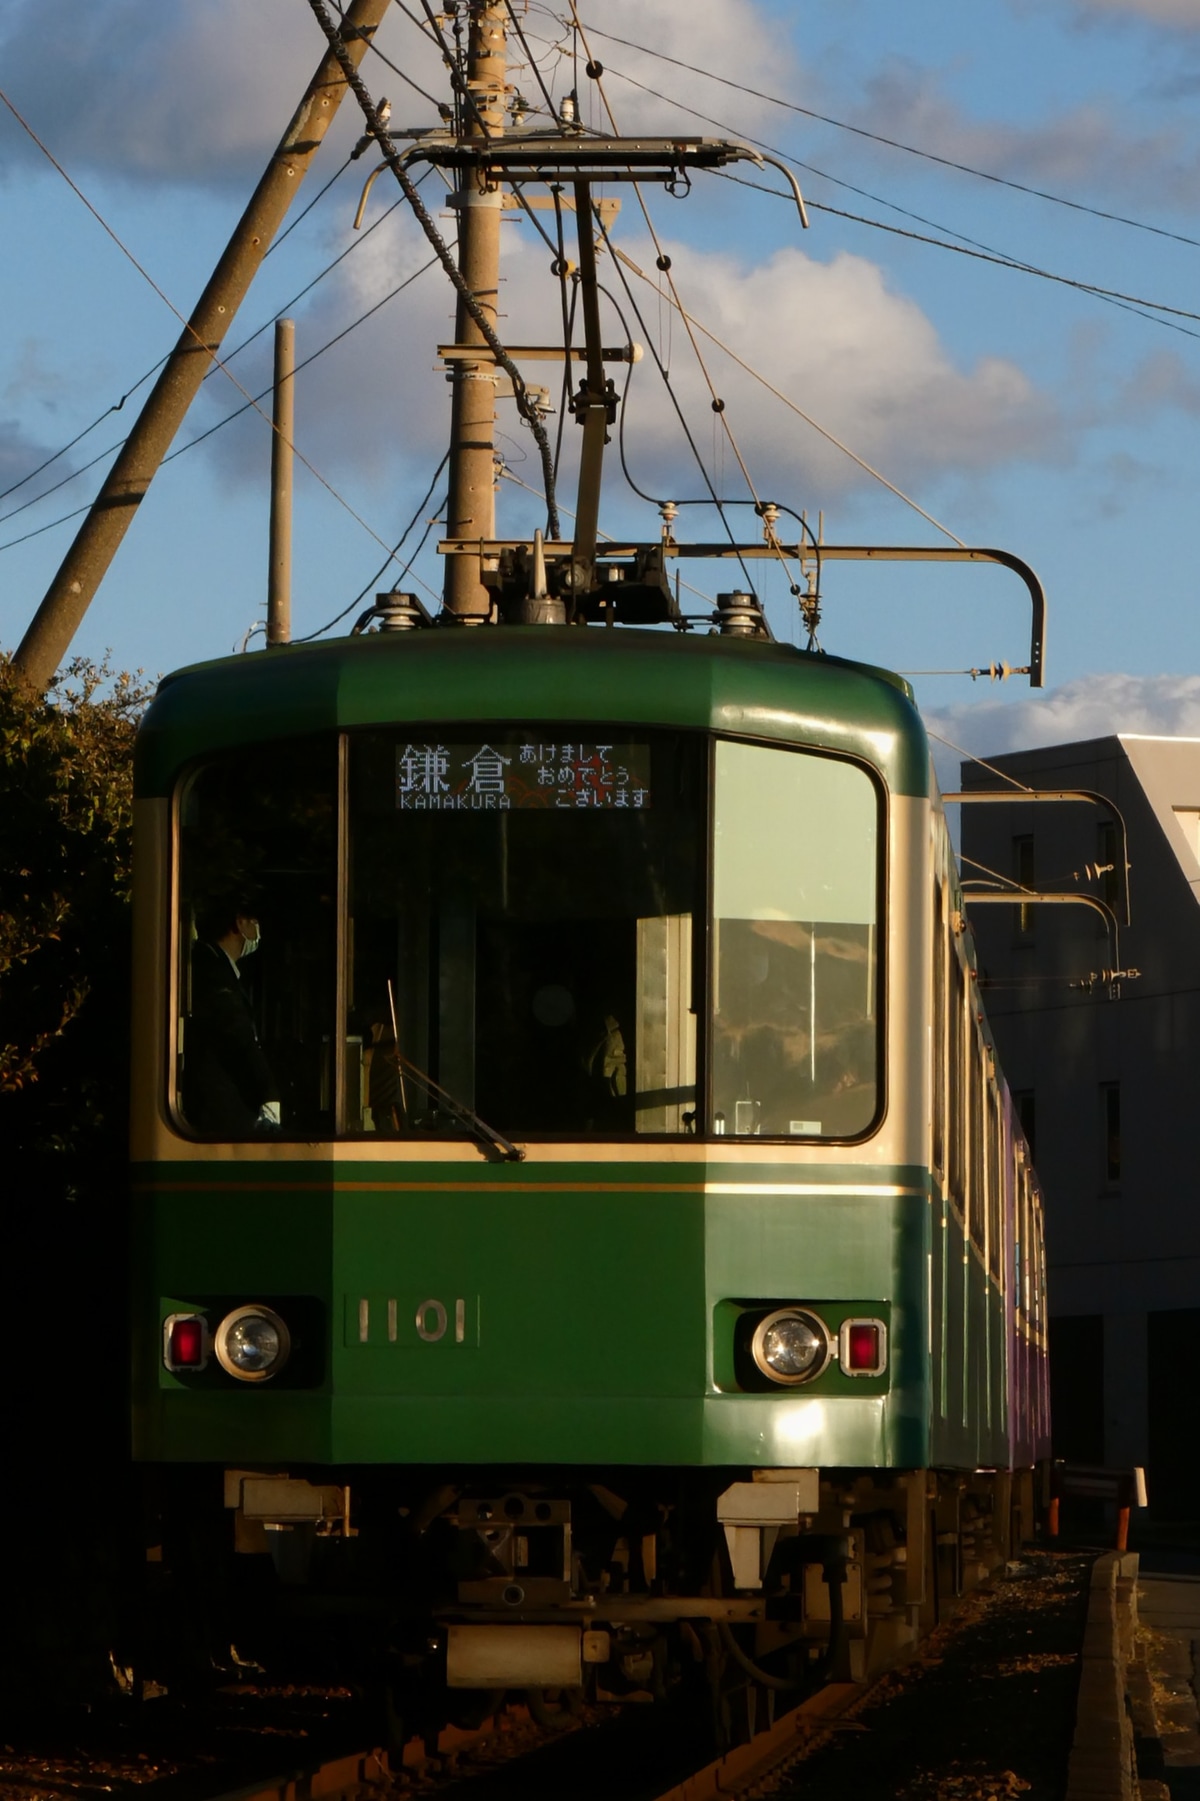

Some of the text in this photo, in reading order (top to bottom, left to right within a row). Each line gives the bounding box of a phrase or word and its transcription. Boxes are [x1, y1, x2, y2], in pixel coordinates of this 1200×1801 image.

[519, 744, 613, 763] あけまして
[399, 744, 512, 793] 鎌倉
[537, 766, 630, 785] おめでとう
[400, 794, 511, 809] KAMAKURA
[555, 788, 649, 808] ございます
[359, 1299, 465, 1343] 1101
